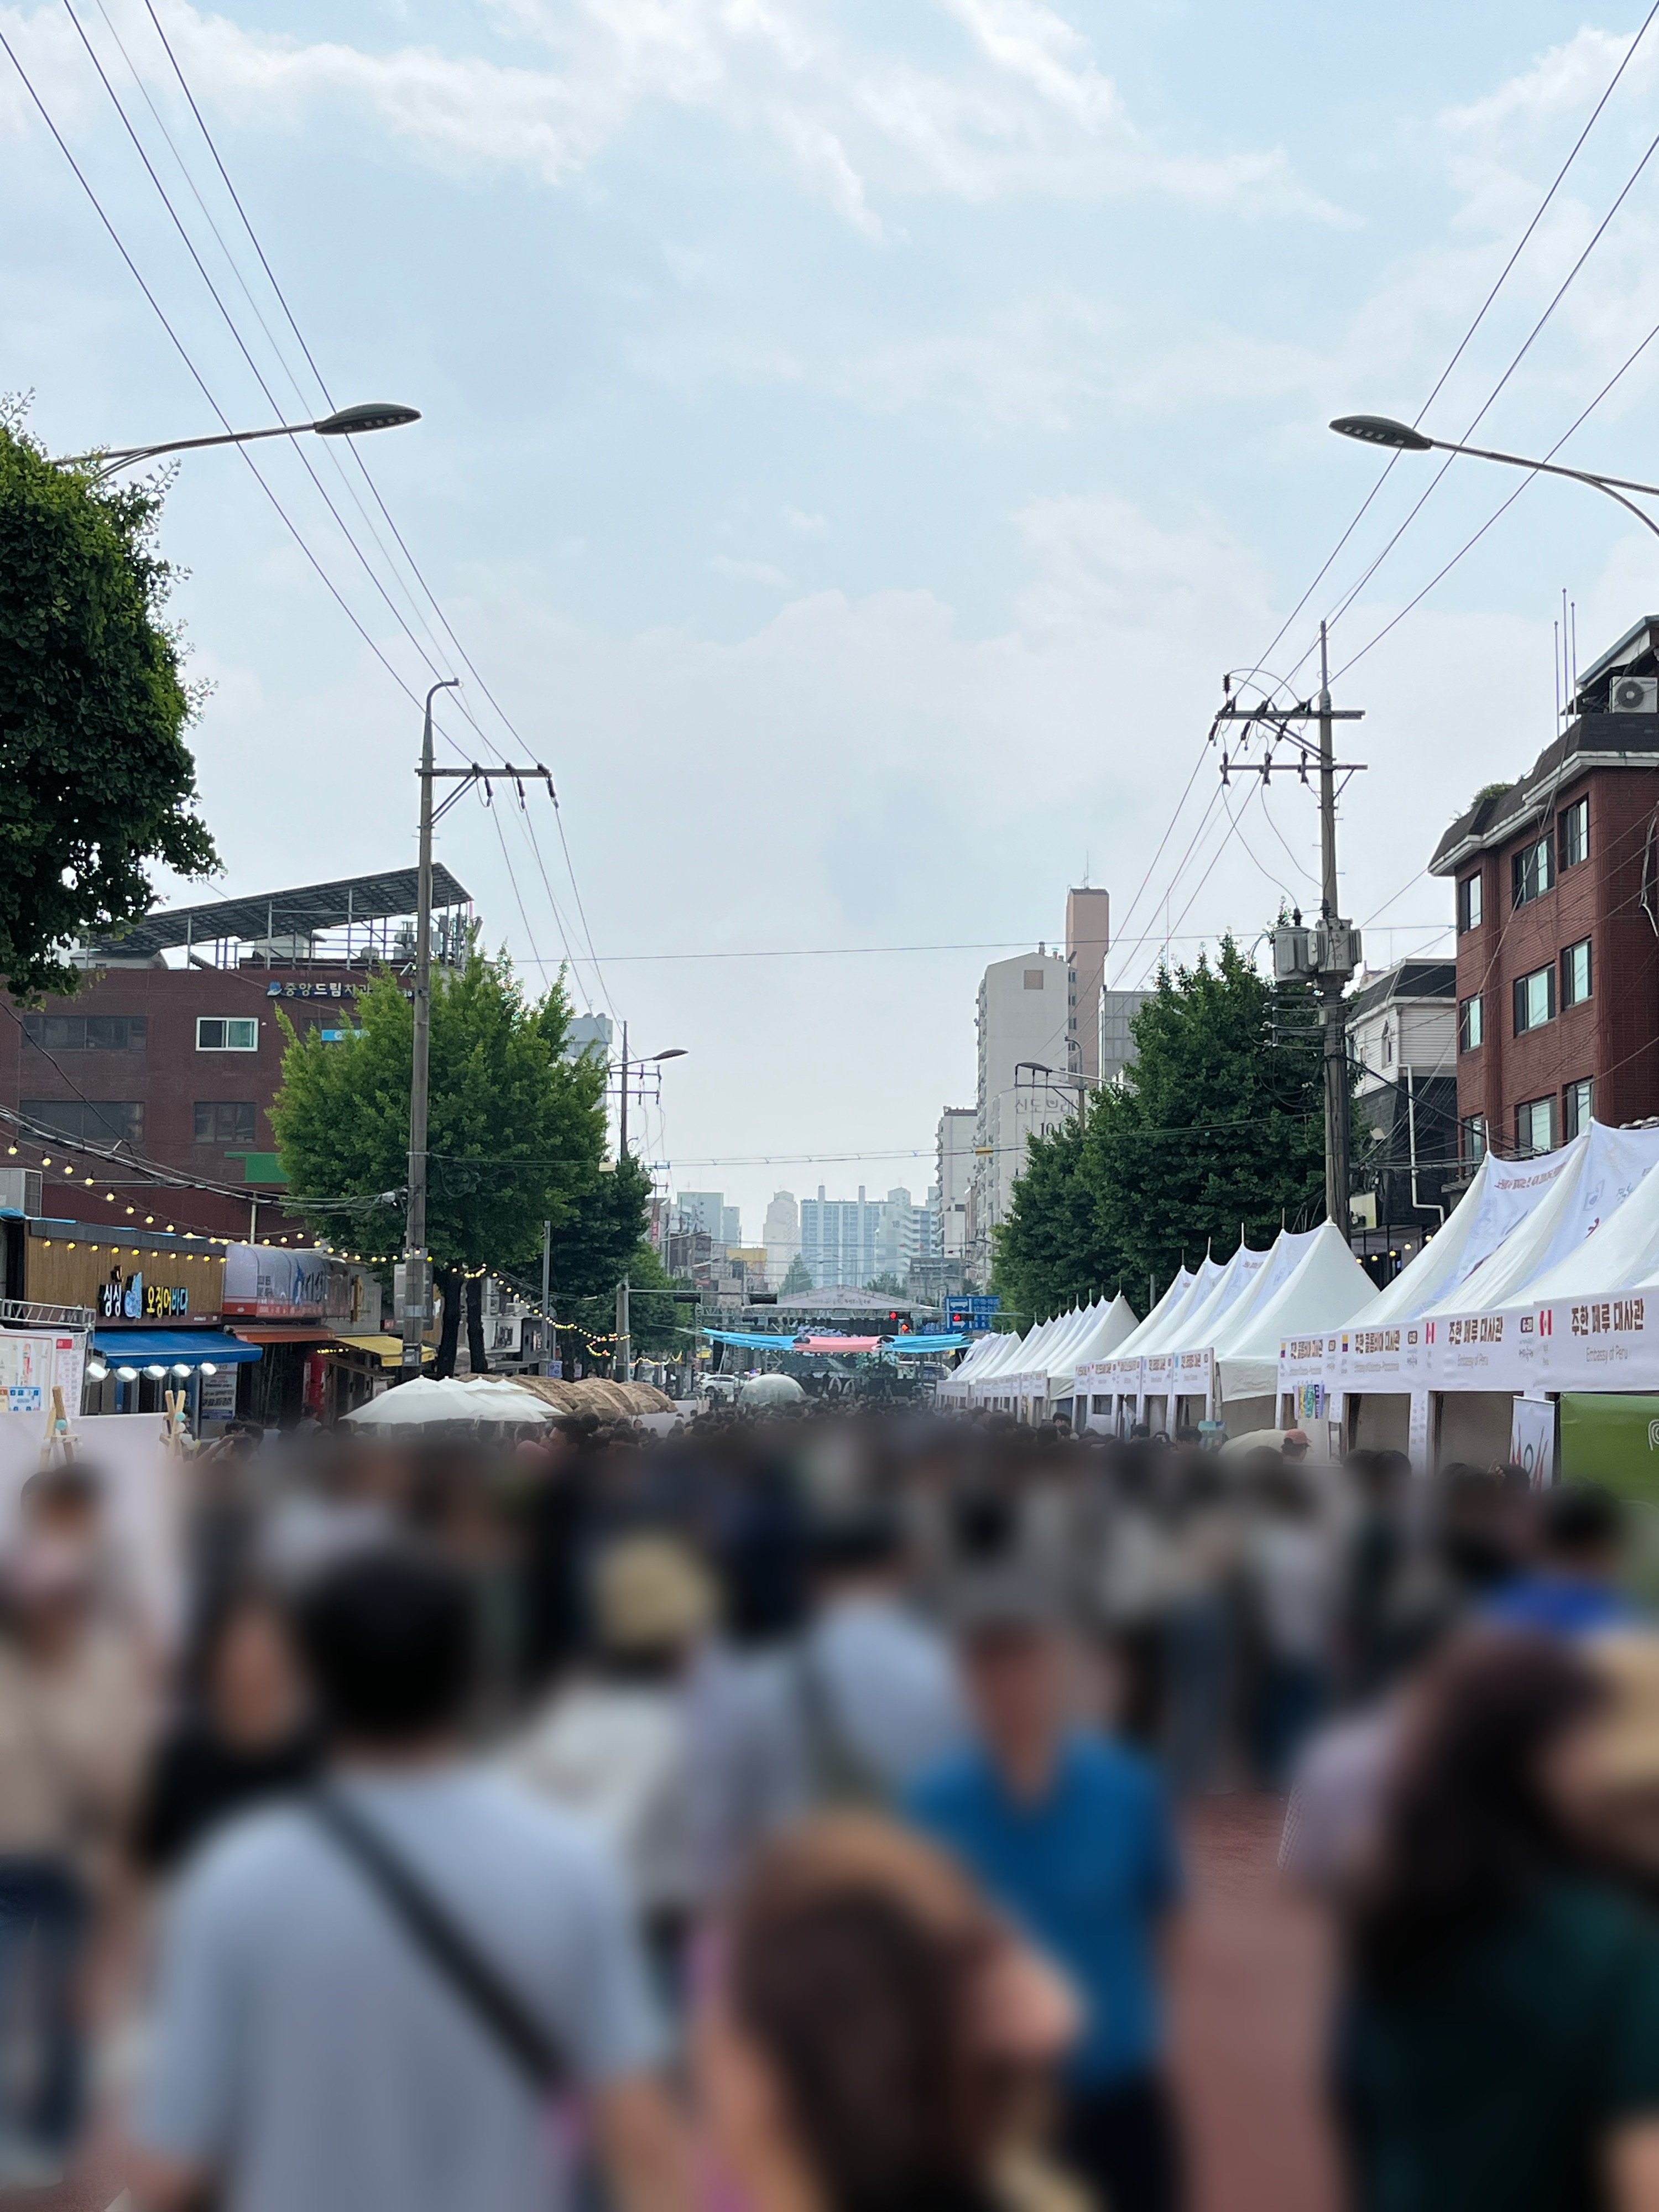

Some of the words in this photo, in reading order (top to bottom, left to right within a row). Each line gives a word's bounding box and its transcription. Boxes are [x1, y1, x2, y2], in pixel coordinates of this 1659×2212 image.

[284, 982, 374, 997] 중앙드림치과
[891, 1220, 900, 1228] 18
[103, 1284, 122, 1317] 싱싱
[147, 1286, 189, 1318] 오징어바다
[1571, 1305, 1589, 1336] 주한
[1592, 1303, 1610, 1334] 페루
[1613, 1298, 1644, 1331] 대사관
[1448, 1319, 1462, 1345] 주한
[1463, 1318, 1478, 1344] 페루
[1480, 1316, 1503, 1342] 대사관
[1586, 1347, 1608, 1364] Embassy
[1609, 1345, 1614, 1360] of
[1615, 1344, 1629, 1360] Peru
